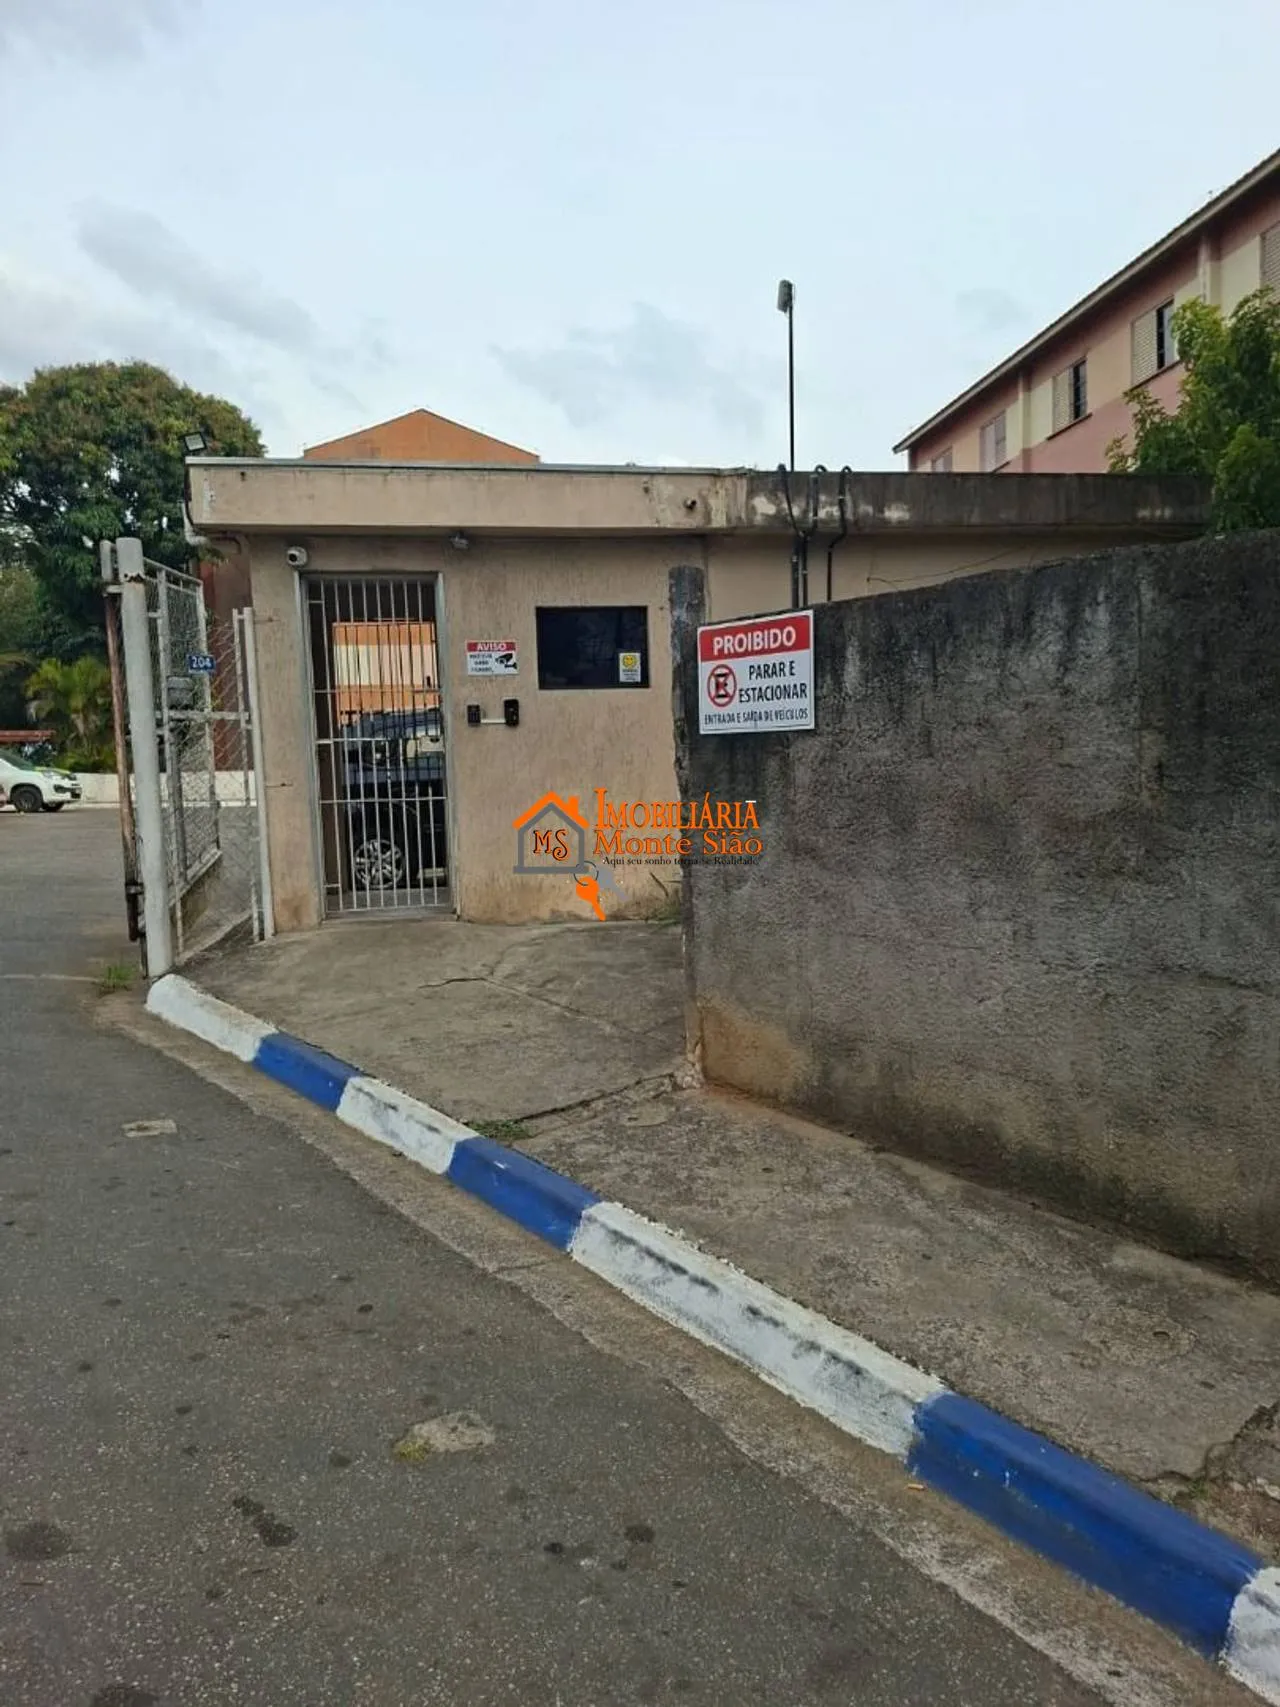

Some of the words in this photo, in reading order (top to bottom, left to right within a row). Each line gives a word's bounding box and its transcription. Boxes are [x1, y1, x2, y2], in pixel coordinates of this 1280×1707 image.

[477, 642, 507, 651] AVISO
[712, 625, 797, 656] PROIBIDO
[748, 662, 786, 680] PARAR
[788, 660, 796, 676] E
[739, 682, 808, 703] ESTACIONAR
[704, 712, 735, 725] ENTRADA
[736, 711, 741, 723] E
[764, 709, 773, 721] DE
